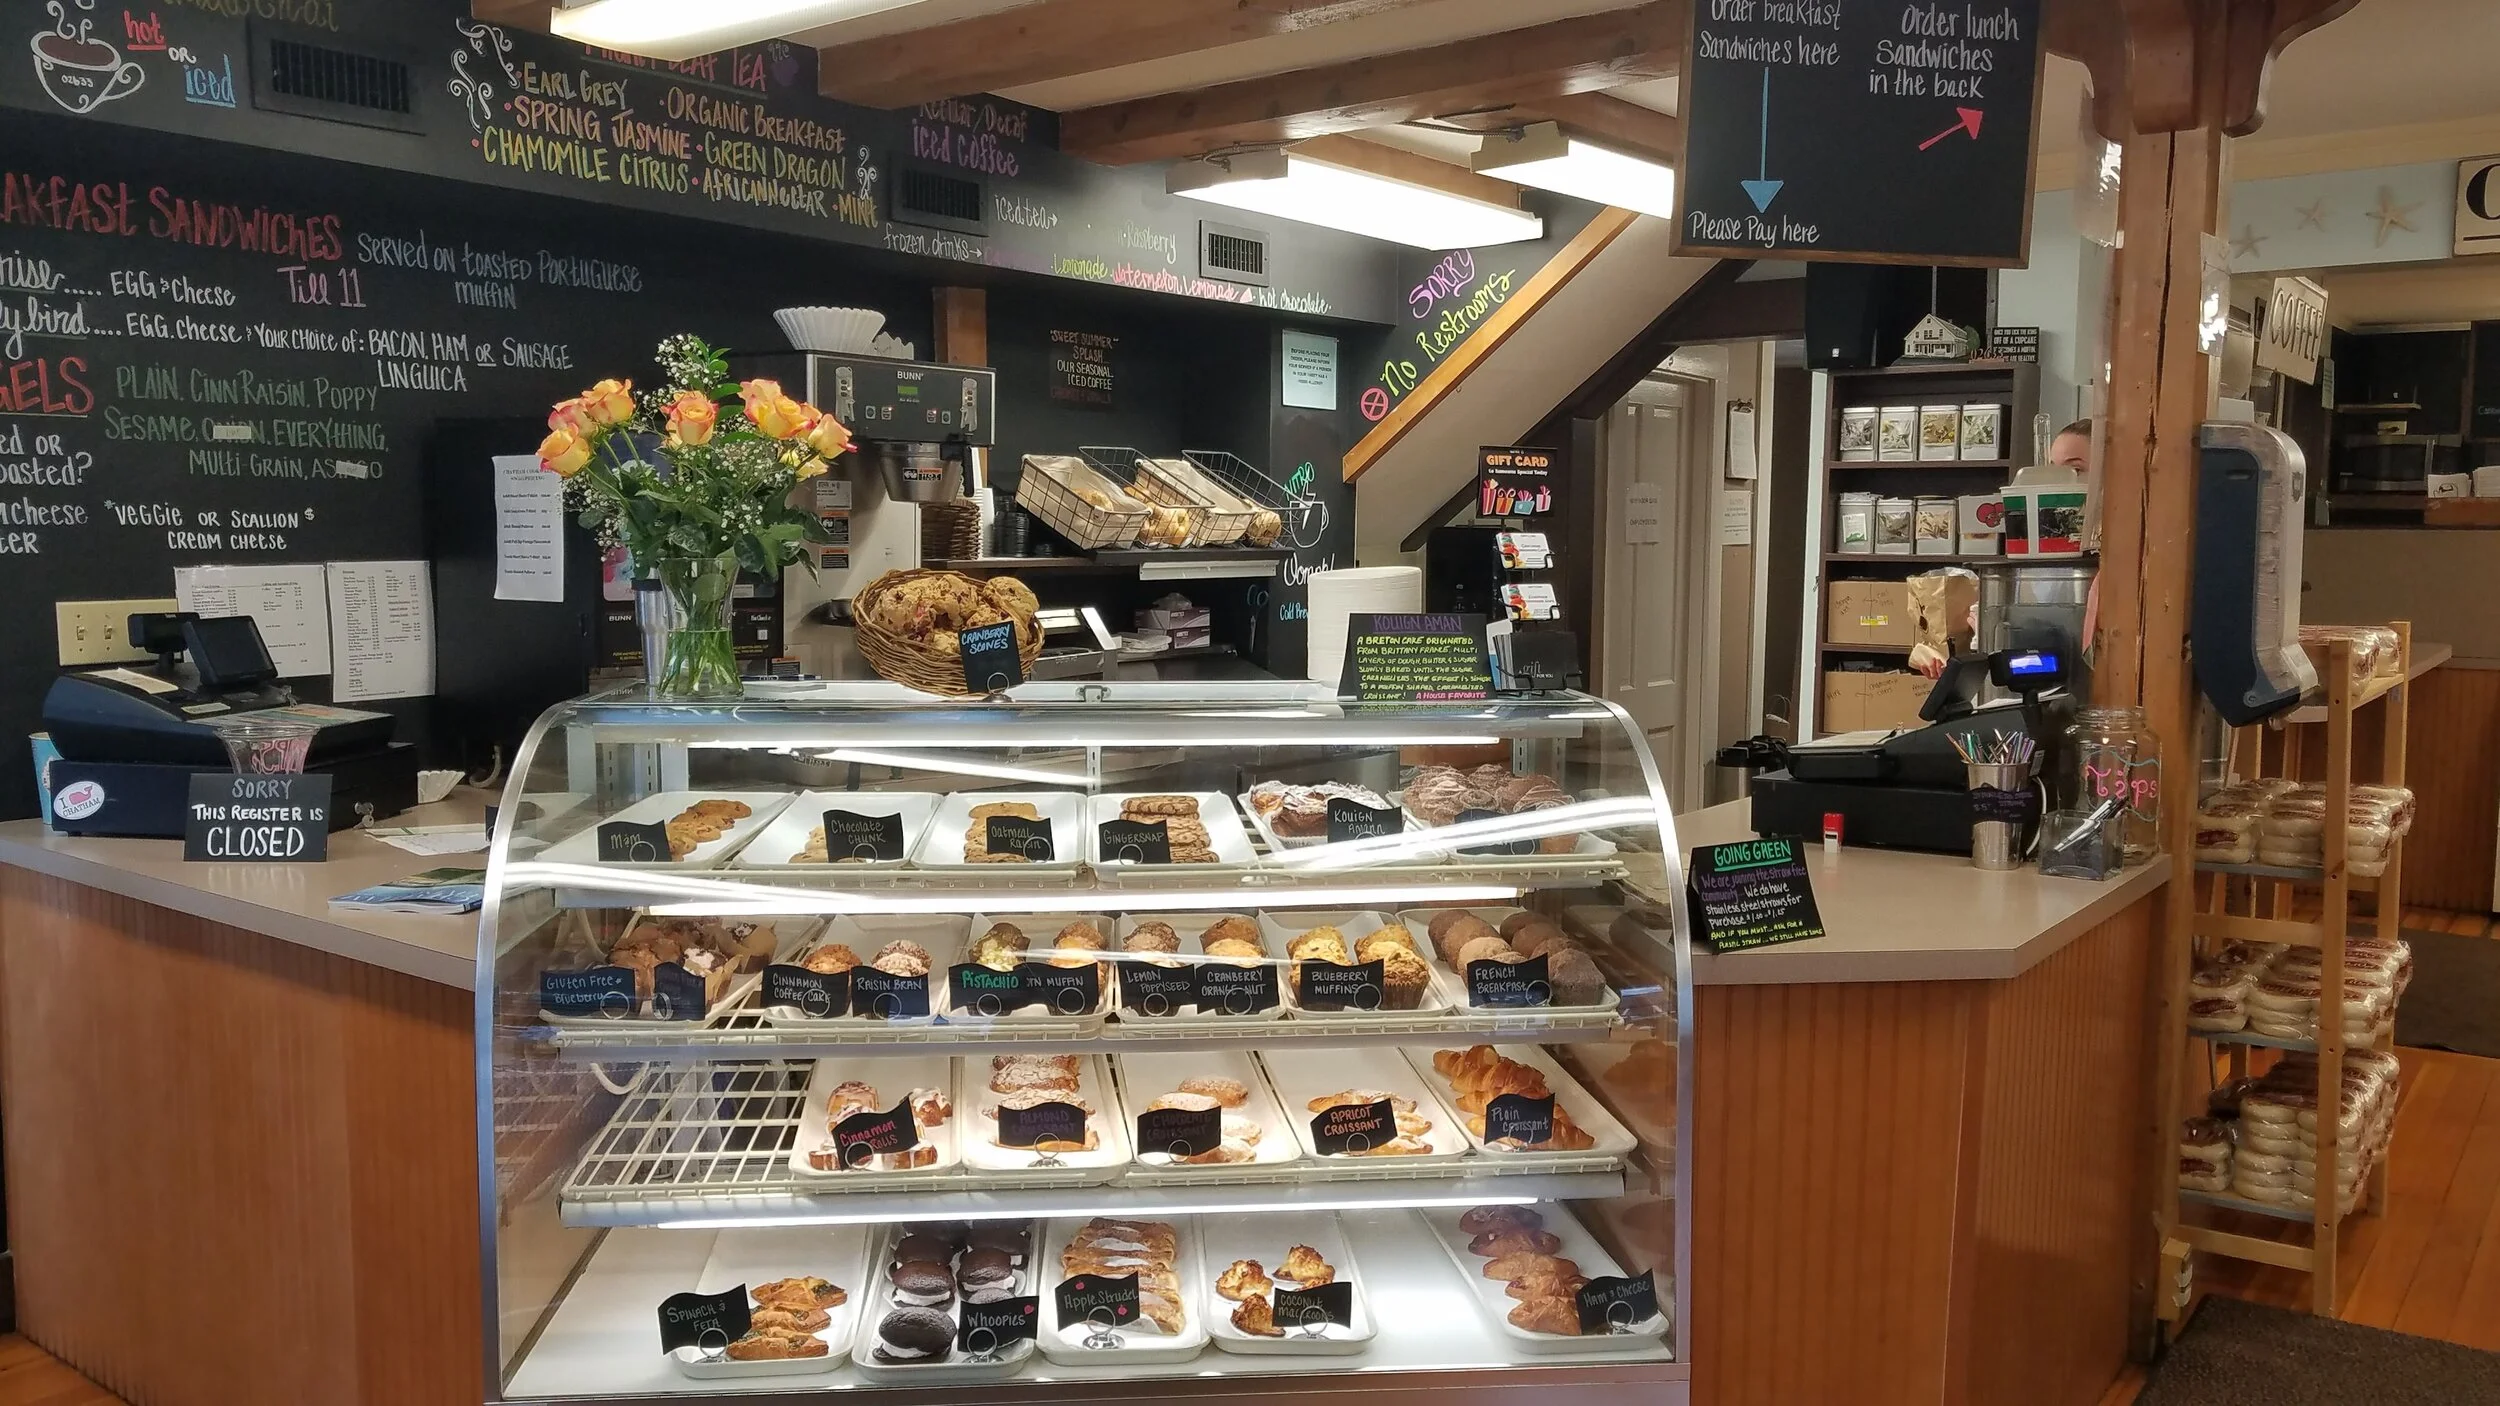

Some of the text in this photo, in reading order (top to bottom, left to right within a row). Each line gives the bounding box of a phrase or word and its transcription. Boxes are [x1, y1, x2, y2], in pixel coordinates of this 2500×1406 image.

[1764, 0, 1841, 31] breakfast
[1901, 4, 2019, 41] Order lunch
[124, 11, 166, 42] hot
[1700, 30, 1840, 66] Sandwiches here
[1876, 40, 1993, 72] Sandwiches
[185, 54, 235, 102] iced
[733, 48, 767, 91] TEA
[523, 61, 629, 110] EARL GREY
[1870, 69, 1984, 99] in the back
[667, 87, 750, 134] ORGANiC
[514, 96, 693, 161] SPRiNG JASMiNE
[912, 118, 1019, 177] iced coffee
[483, 126, 689, 194] CHAMOMiLE CiTRUS
[705, 132, 846, 190] GREEN DRAGON
[994, 194, 1051, 230] iced tea
[1687, 210, 1820, 249] Please Pay here
[883, 222, 932, 256] frozen
[932, 229, 970, 261] drinks
[1054, 254, 1109, 281] Lemonade
[110, 270, 236, 307] EGG Cheese
[277, 265, 367, 308] Till 11
[1409, 248, 1476, 319] SORRY
[1380, 360, 1417, 397] No
[1416, 269, 1516, 362] Restrooms
[2271, 288, 2323, 362] COFFEE
[2015, 336, 2036, 344] CUPCAKE
[432, 332, 470, 363] HAM
[502, 337, 574, 371] SAUSAGE
[377, 360, 468, 393] LINGUICA
[897, 371, 921, 380] BUNN
[1057, 360, 1075, 373] OUR
[1067, 373, 1112, 391] ICED COFFEE
[314, 377, 378, 411] POPPY
[1486, 455, 1548, 467] GIFT CARD
[198, 510, 220, 528] OR
[231, 511, 299, 530] SCALLION
[1373, 615, 1463, 632] KOUIGN AMAN
[1365, 636, 1400, 645] BRETON
[1357, 647, 1378, 655] FROM
[232, 778, 293, 799] SORRY
[62, 798, 101, 817] CHATHAM
[191, 804, 324, 821] THIS REGISTER IS
[830, 819, 884, 835] Chocolate
[991, 825, 1035, 839] Oatmeal
[207, 826, 305, 858] CLOSED
[1102, 829, 1166, 846] GINGERSNAP
[1714, 840, 1792, 866] GOING GREEN
[1743, 884, 1760, 898] We
[1769, 881, 1790, 893] have
[1707, 916, 1747, 930] purchase
[546, 976, 613, 990] Gluten Free
[772, 976, 823, 990] CINNAMON
[857, 977, 923, 991] RAISIN BRAN
[1126, 970, 1161, 983] LEMON
[1207, 970, 1264, 982] CRANBERRY
[1311, 970, 1369, 982] BLUEBERRY
[1475, 967, 1516, 981] FRENCH
[773, 988, 802, 1001] COFFEE
[1141, 981, 1190, 993] POPPYSEED
[1331, 1106, 1373, 1122] APRICOT
[1491, 1106, 1520, 1122] Plain
[840, 1120, 897, 1147] Cinnamon
[1324, 1118, 1383, 1136] CROISSANT
[870, 1134, 898, 1150] Rolls
[1064, 1288, 1139, 1314] Apple Strudel
[1583, 1292, 1608, 1308] Ham
[667, 1304, 716, 1324] SPINACH
[693, 1317, 720, 1331] FETA
[968, 1312, 1026, 1327] Whoopies
